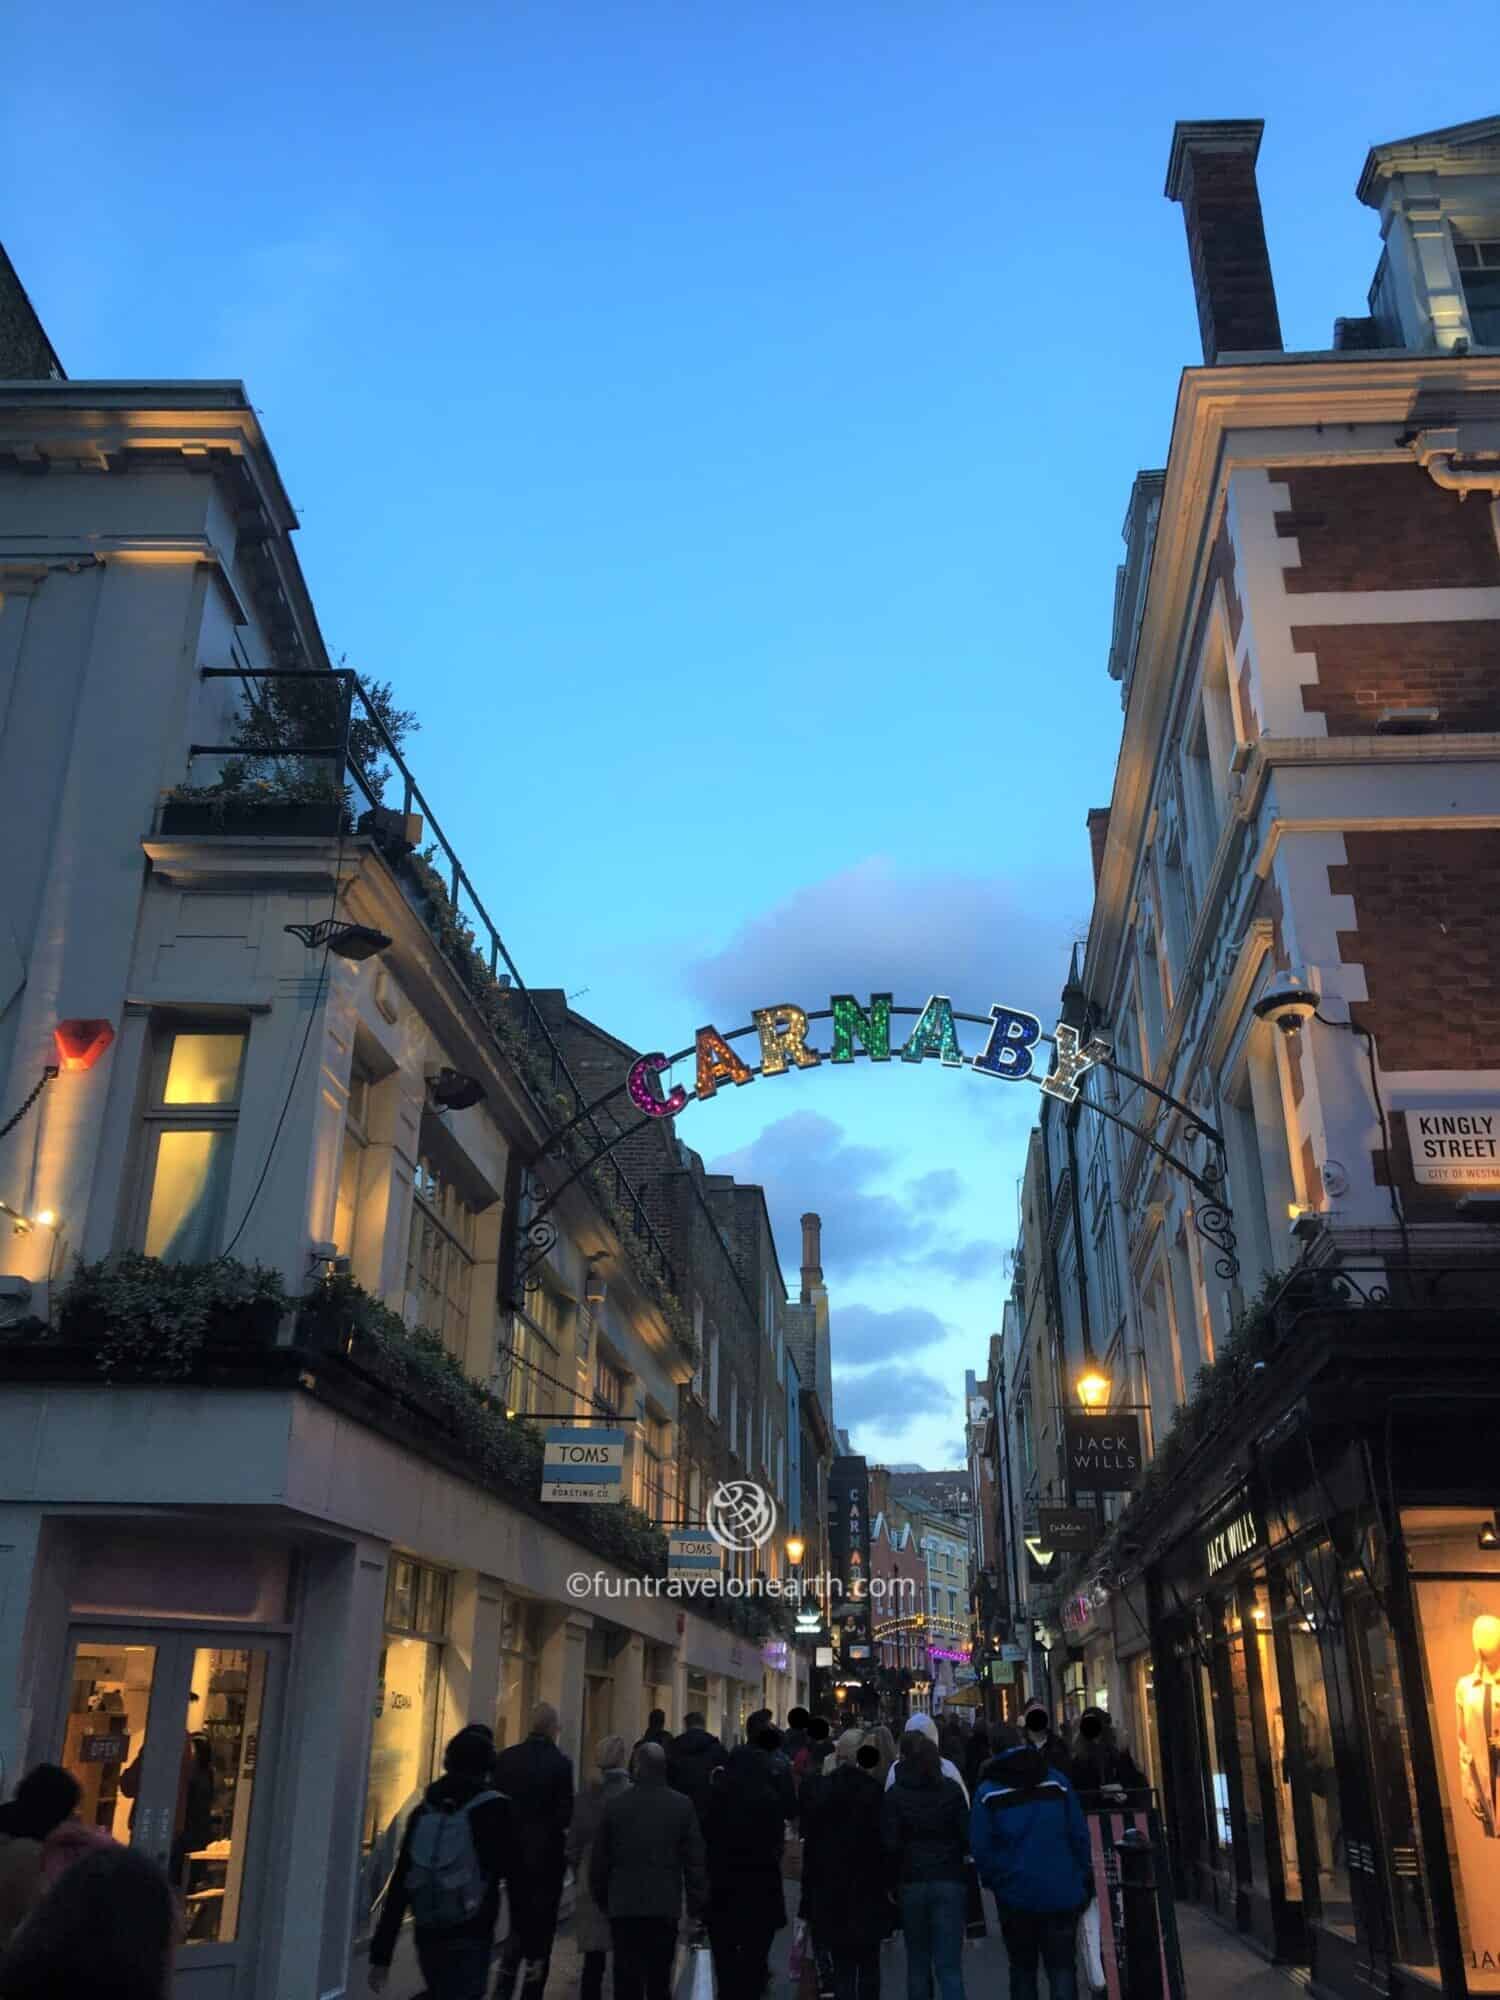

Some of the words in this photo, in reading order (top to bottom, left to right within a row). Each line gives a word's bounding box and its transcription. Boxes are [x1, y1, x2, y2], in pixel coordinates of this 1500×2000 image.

[626, 993, 1112, 1118] CARNABY
[1419, 1116, 1493, 1135] KINGLY
[1424, 1139, 1497, 1158] STREET
[1428, 1168, 1448, 1178] CITY
[1452, 1168, 1462, 1178] OF
[1077, 1435, 1127, 1450] JACK
[560, 1446, 609, 1463] TOMS
[1073, 1455, 1136, 1469] WILLS
[680, 1542, 712, 1555] TOMS
[1207, 1532, 1228, 1577] JACK
[1227, 1511, 1256, 1559] WILLS
[1471, 1951, 1500, 1969] JA
